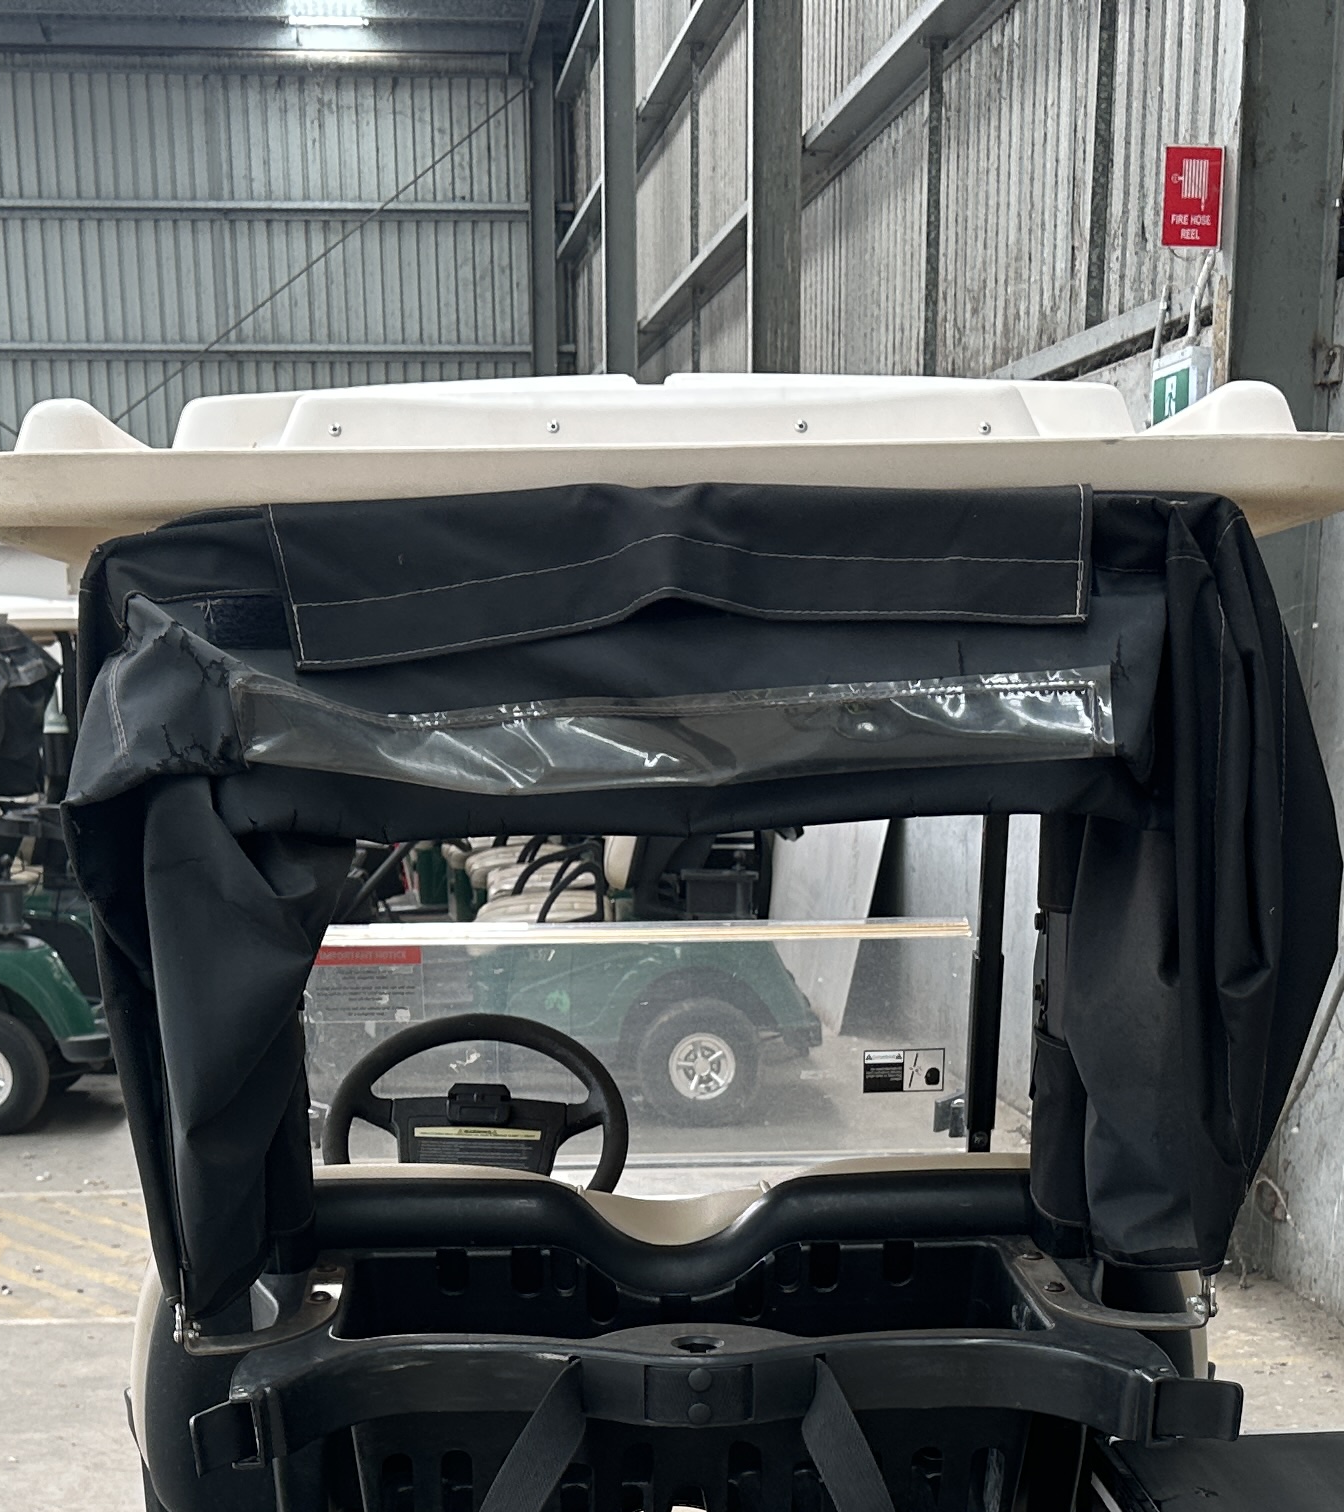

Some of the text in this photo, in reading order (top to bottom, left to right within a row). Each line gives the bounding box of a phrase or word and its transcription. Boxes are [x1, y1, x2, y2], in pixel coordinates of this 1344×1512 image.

[1171, 214, 1211, 226] FIRE HOSE
[1180, 228, 1200, 240] REEL
